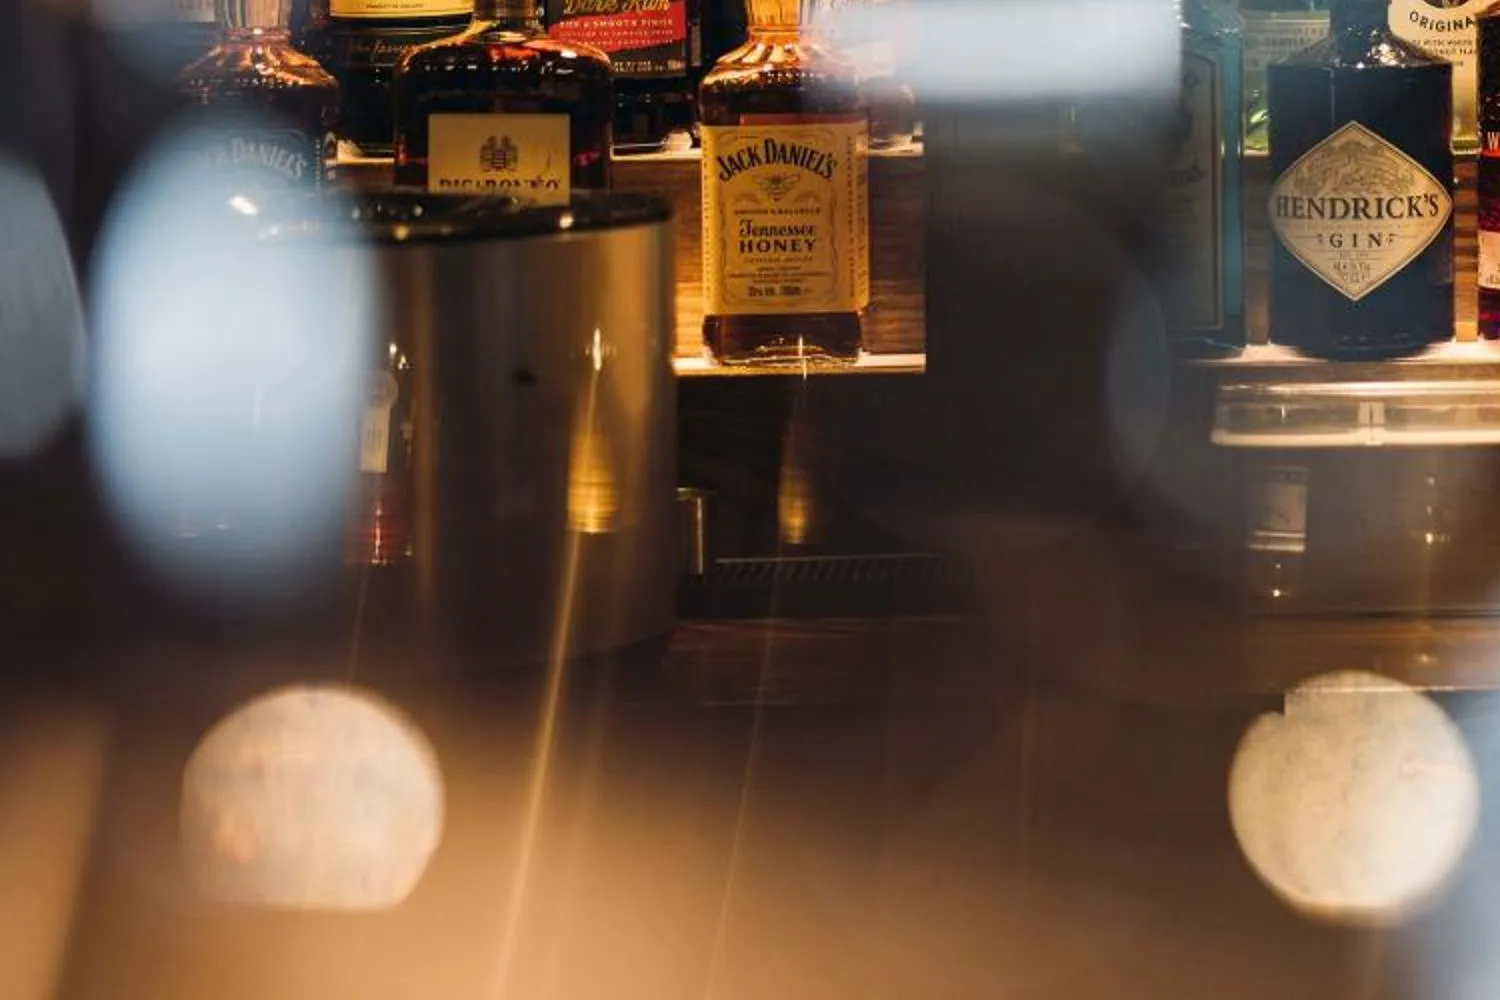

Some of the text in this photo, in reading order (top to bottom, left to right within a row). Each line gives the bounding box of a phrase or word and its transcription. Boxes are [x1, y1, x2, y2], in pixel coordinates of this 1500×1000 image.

[1408, 10, 1477, 33] ORIGINA
[716, 138, 837, 182] JACK DANIEL'S
[1276, 193, 1440, 221] HENDRICK'S
[739, 219, 815, 238] Tennessee
[739, 238, 817, 254] HONEY
[1329, 233, 1383, 249] GIN
